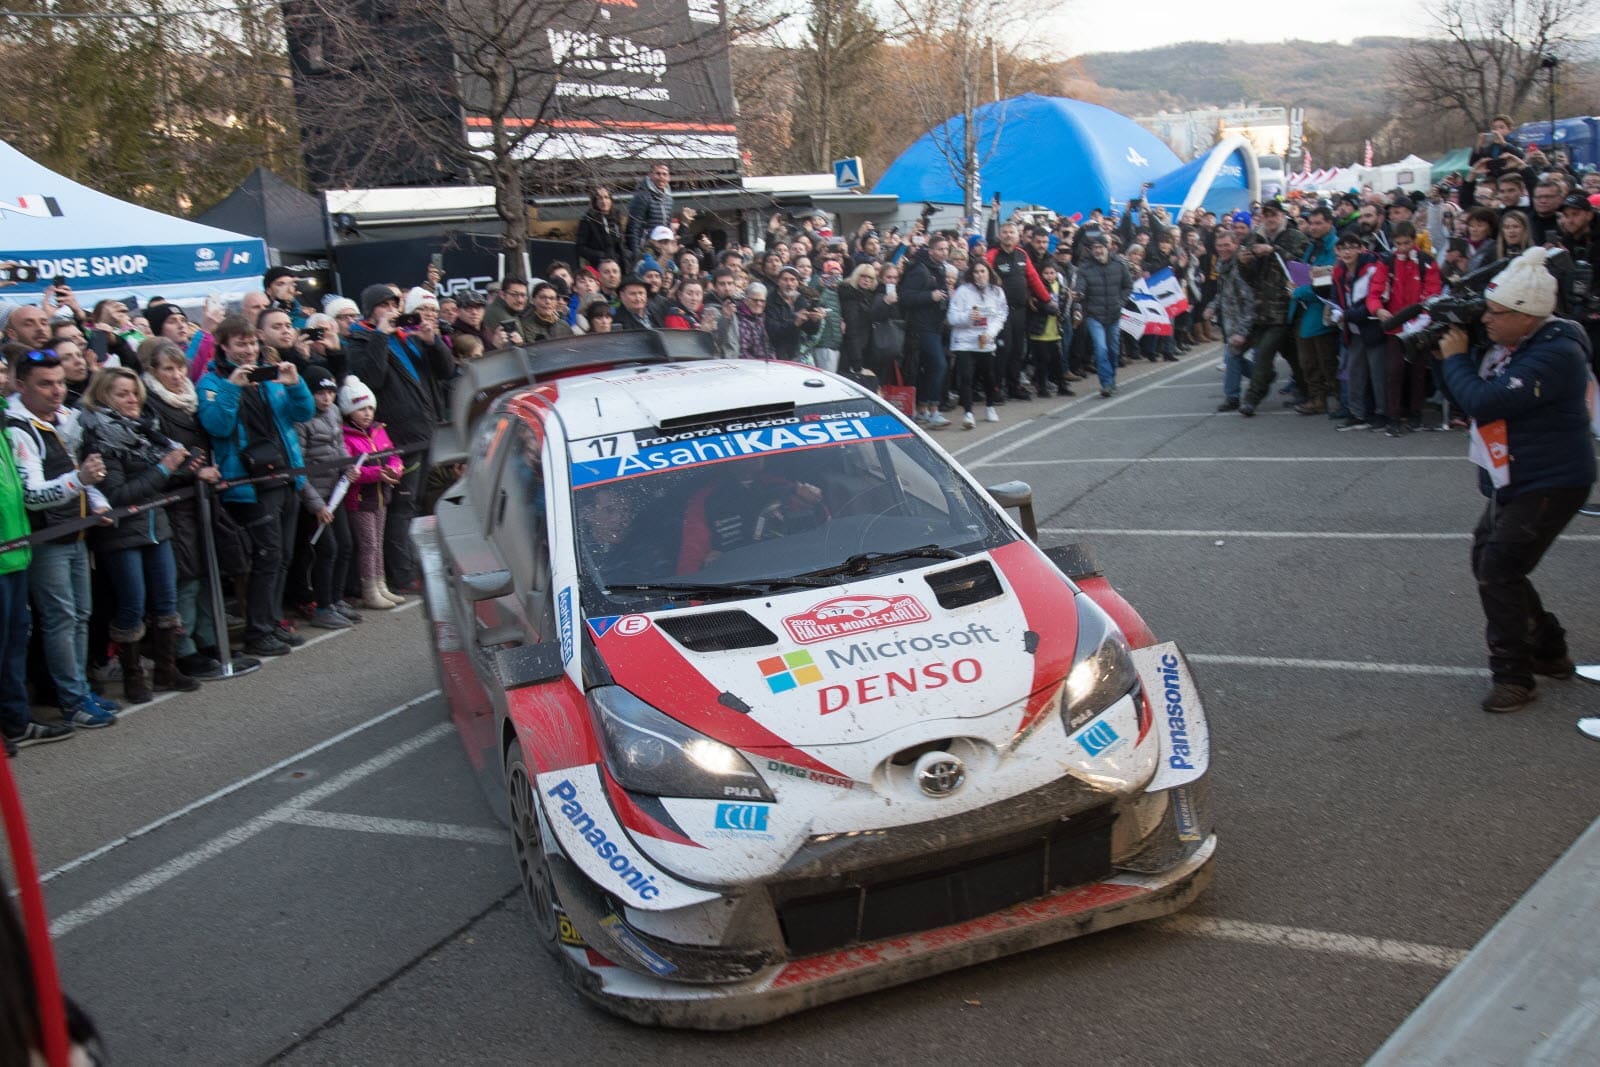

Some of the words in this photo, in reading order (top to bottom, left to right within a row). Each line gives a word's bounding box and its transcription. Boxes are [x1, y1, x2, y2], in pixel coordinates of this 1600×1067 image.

[90, 254, 149, 277] SHOP
[587, 436, 619, 458] 17
[616, 419, 873, 477] AsahiKASEI
[637, 427, 721, 447] TOYOTA
[726, 417, 800, 436] GAZOO
[803, 411, 871, 422] Racing
[795, 623, 841, 642] RALLYE
[840, 603, 925, 632] MONTE-CARLO
[825, 623, 1000, 670] Microsoft
[817, 658, 983, 716] DENSO
[1157, 654, 1196, 770] Panasonic
[767, 760, 807, 779] DMG
[723, 785, 762, 798] PIAA
[547, 779, 660, 900] Panasonic
